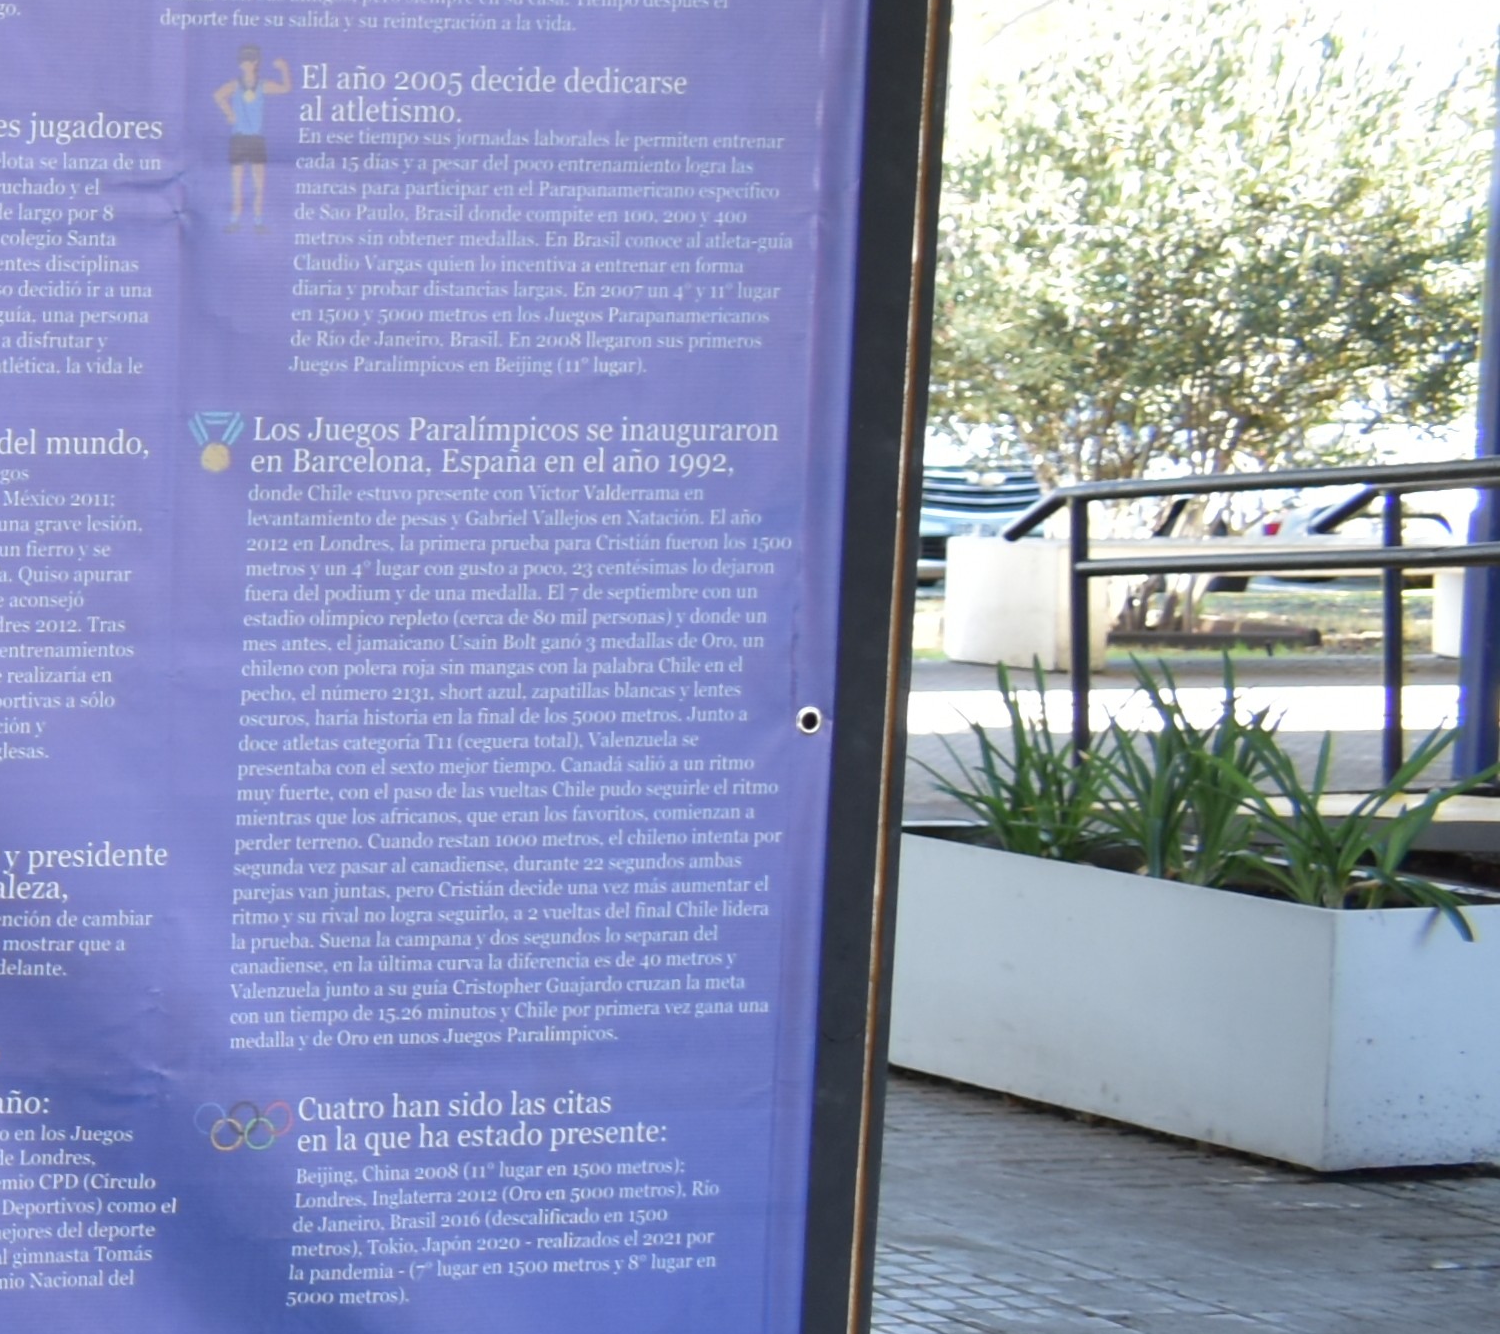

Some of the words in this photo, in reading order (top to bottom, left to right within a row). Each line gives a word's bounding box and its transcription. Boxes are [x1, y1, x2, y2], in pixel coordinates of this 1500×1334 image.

[301, 62, 328, 90] El
[336, 65, 386, 91] año
[394, 71, 463, 97] 2005
[470, 64, 557, 93] decide
[563, 66, 688, 95] dedicarse
[299, 94, 322, 122] al
[330, 95, 462, 124] atletismo.
[25, 111, 163, 145] jugadores
[46, 428, 149, 457] mundo,
[253, 416, 301, 442] Los
[307, 416, 400, 448] Juegos
[408, 415, 579, 448] Paralímpicos
[586, 423, 614, 442] se
[621, 415, 779, 448] inauguraron
[250, 454, 283, 473] en
[292, 446, 432, 473] Barcelona,
[441, 446, 536, 480] España
[544, 455, 574, 473] en
[583, 446, 605, 473] el
[612, 448, 660, 473] año
[668, 453, 734, 478] 1992,
